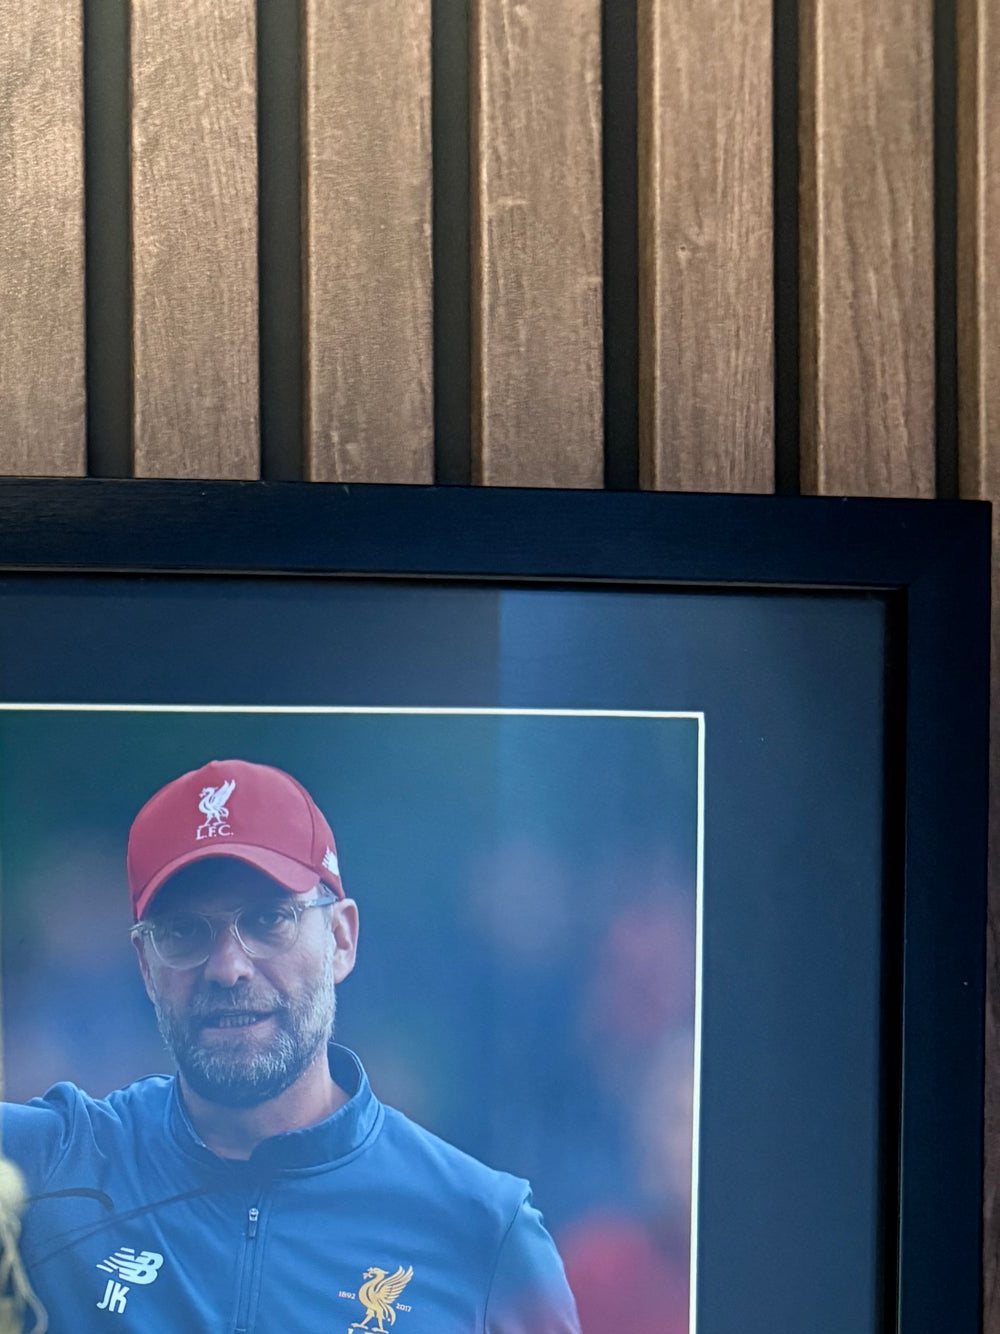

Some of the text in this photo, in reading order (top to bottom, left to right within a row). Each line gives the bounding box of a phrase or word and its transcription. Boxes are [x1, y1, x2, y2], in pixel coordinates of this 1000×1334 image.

[96, 1279, 130, 1314] JK
[338, 1290, 356, 1300] 1892
[395, 1302, 412, 1312] 2017
